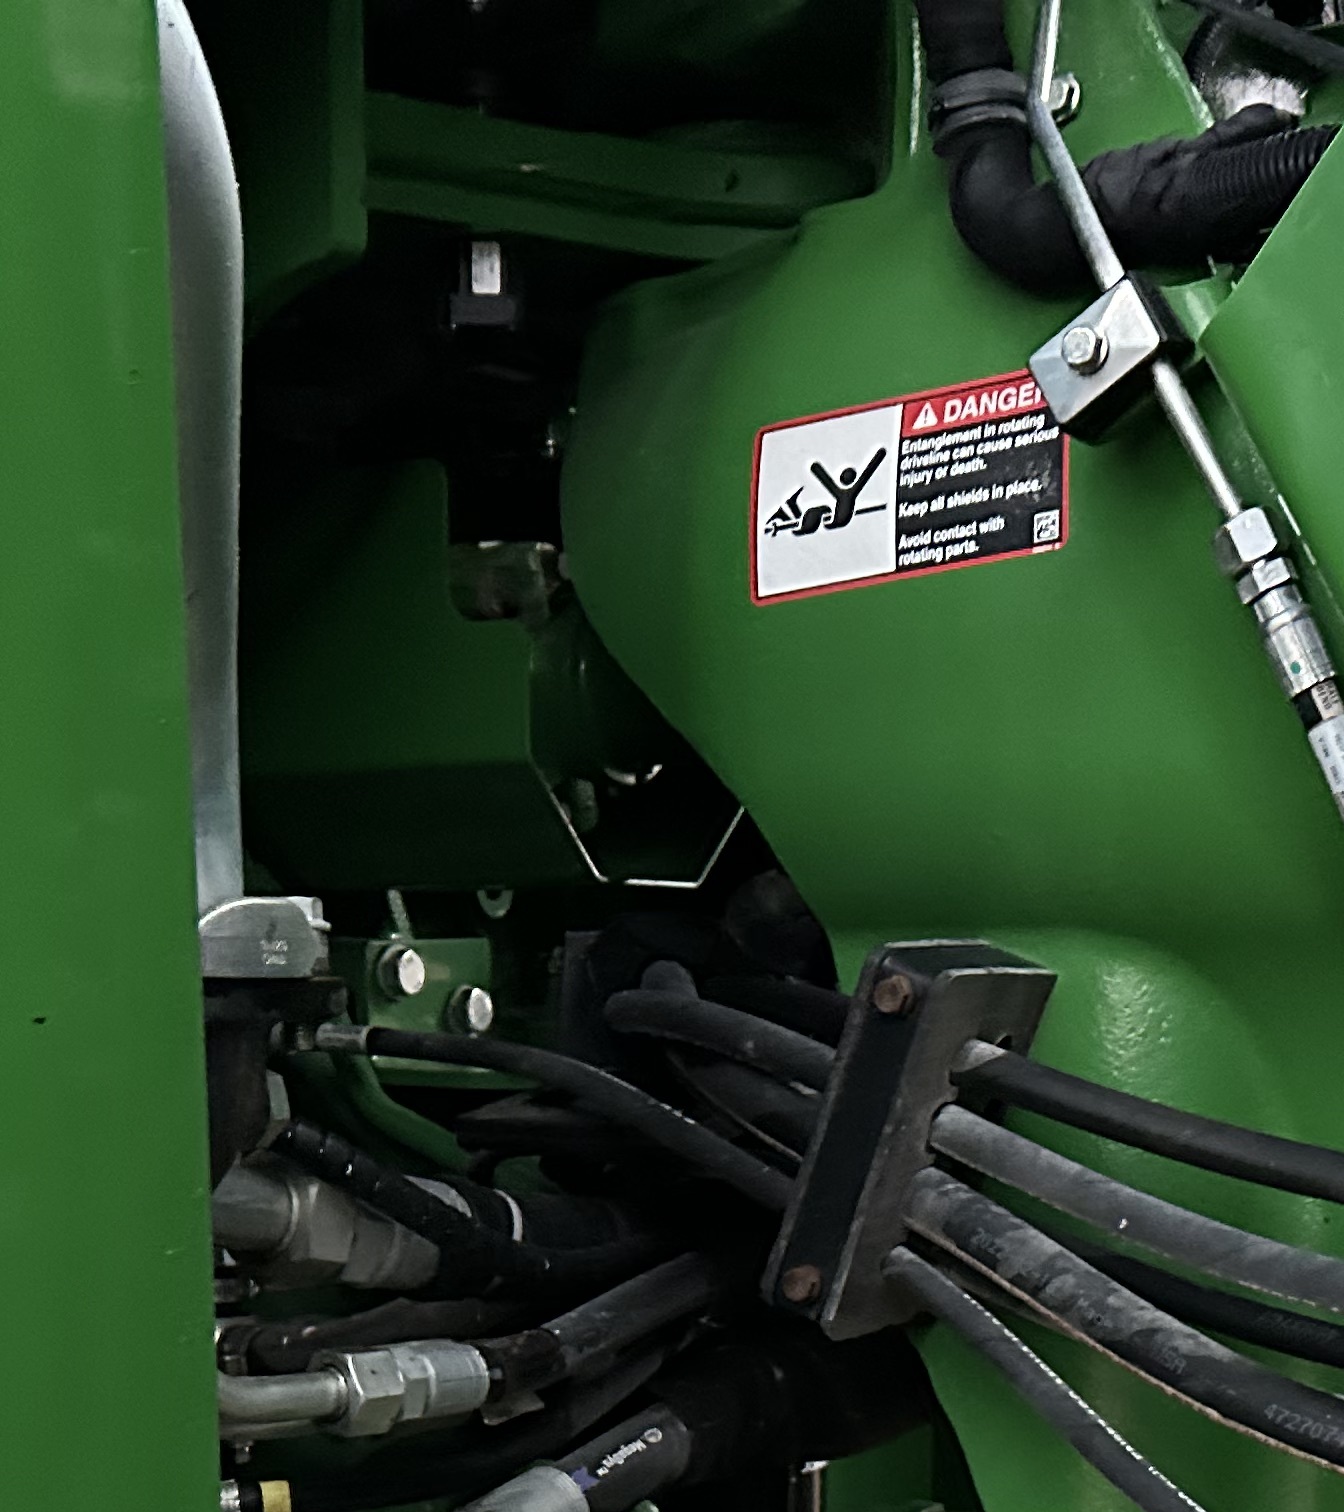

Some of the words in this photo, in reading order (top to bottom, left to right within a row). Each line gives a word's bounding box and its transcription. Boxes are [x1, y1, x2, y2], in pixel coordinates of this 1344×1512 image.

[900, 449, 951, 471] driveline
[952, 444, 975, 461] can
[976, 436, 1013, 455] cause
[1014, 425, 1060, 447] serious
[902, 425, 982, 455] Entanglement
[984, 422, 996, 438] in
[997, 413, 1045, 435] rotating
[899, 467, 934, 489] injury
[934, 464, 950, 480] or
[950, 456, 988, 477] death.
[898, 500, 929, 518] Keep
[929, 494, 946, 512] all
[946, 487, 990, 509] shields
[991, 482, 1004, 499] in
[1005, 477, 1044, 500] place.
[897, 528, 932, 551] Avoid
[933, 520, 978, 544] contact
[978, 514, 1005, 535] with
[898, 546, 944, 567] rotating
[944, 539, 981, 562] parts.
